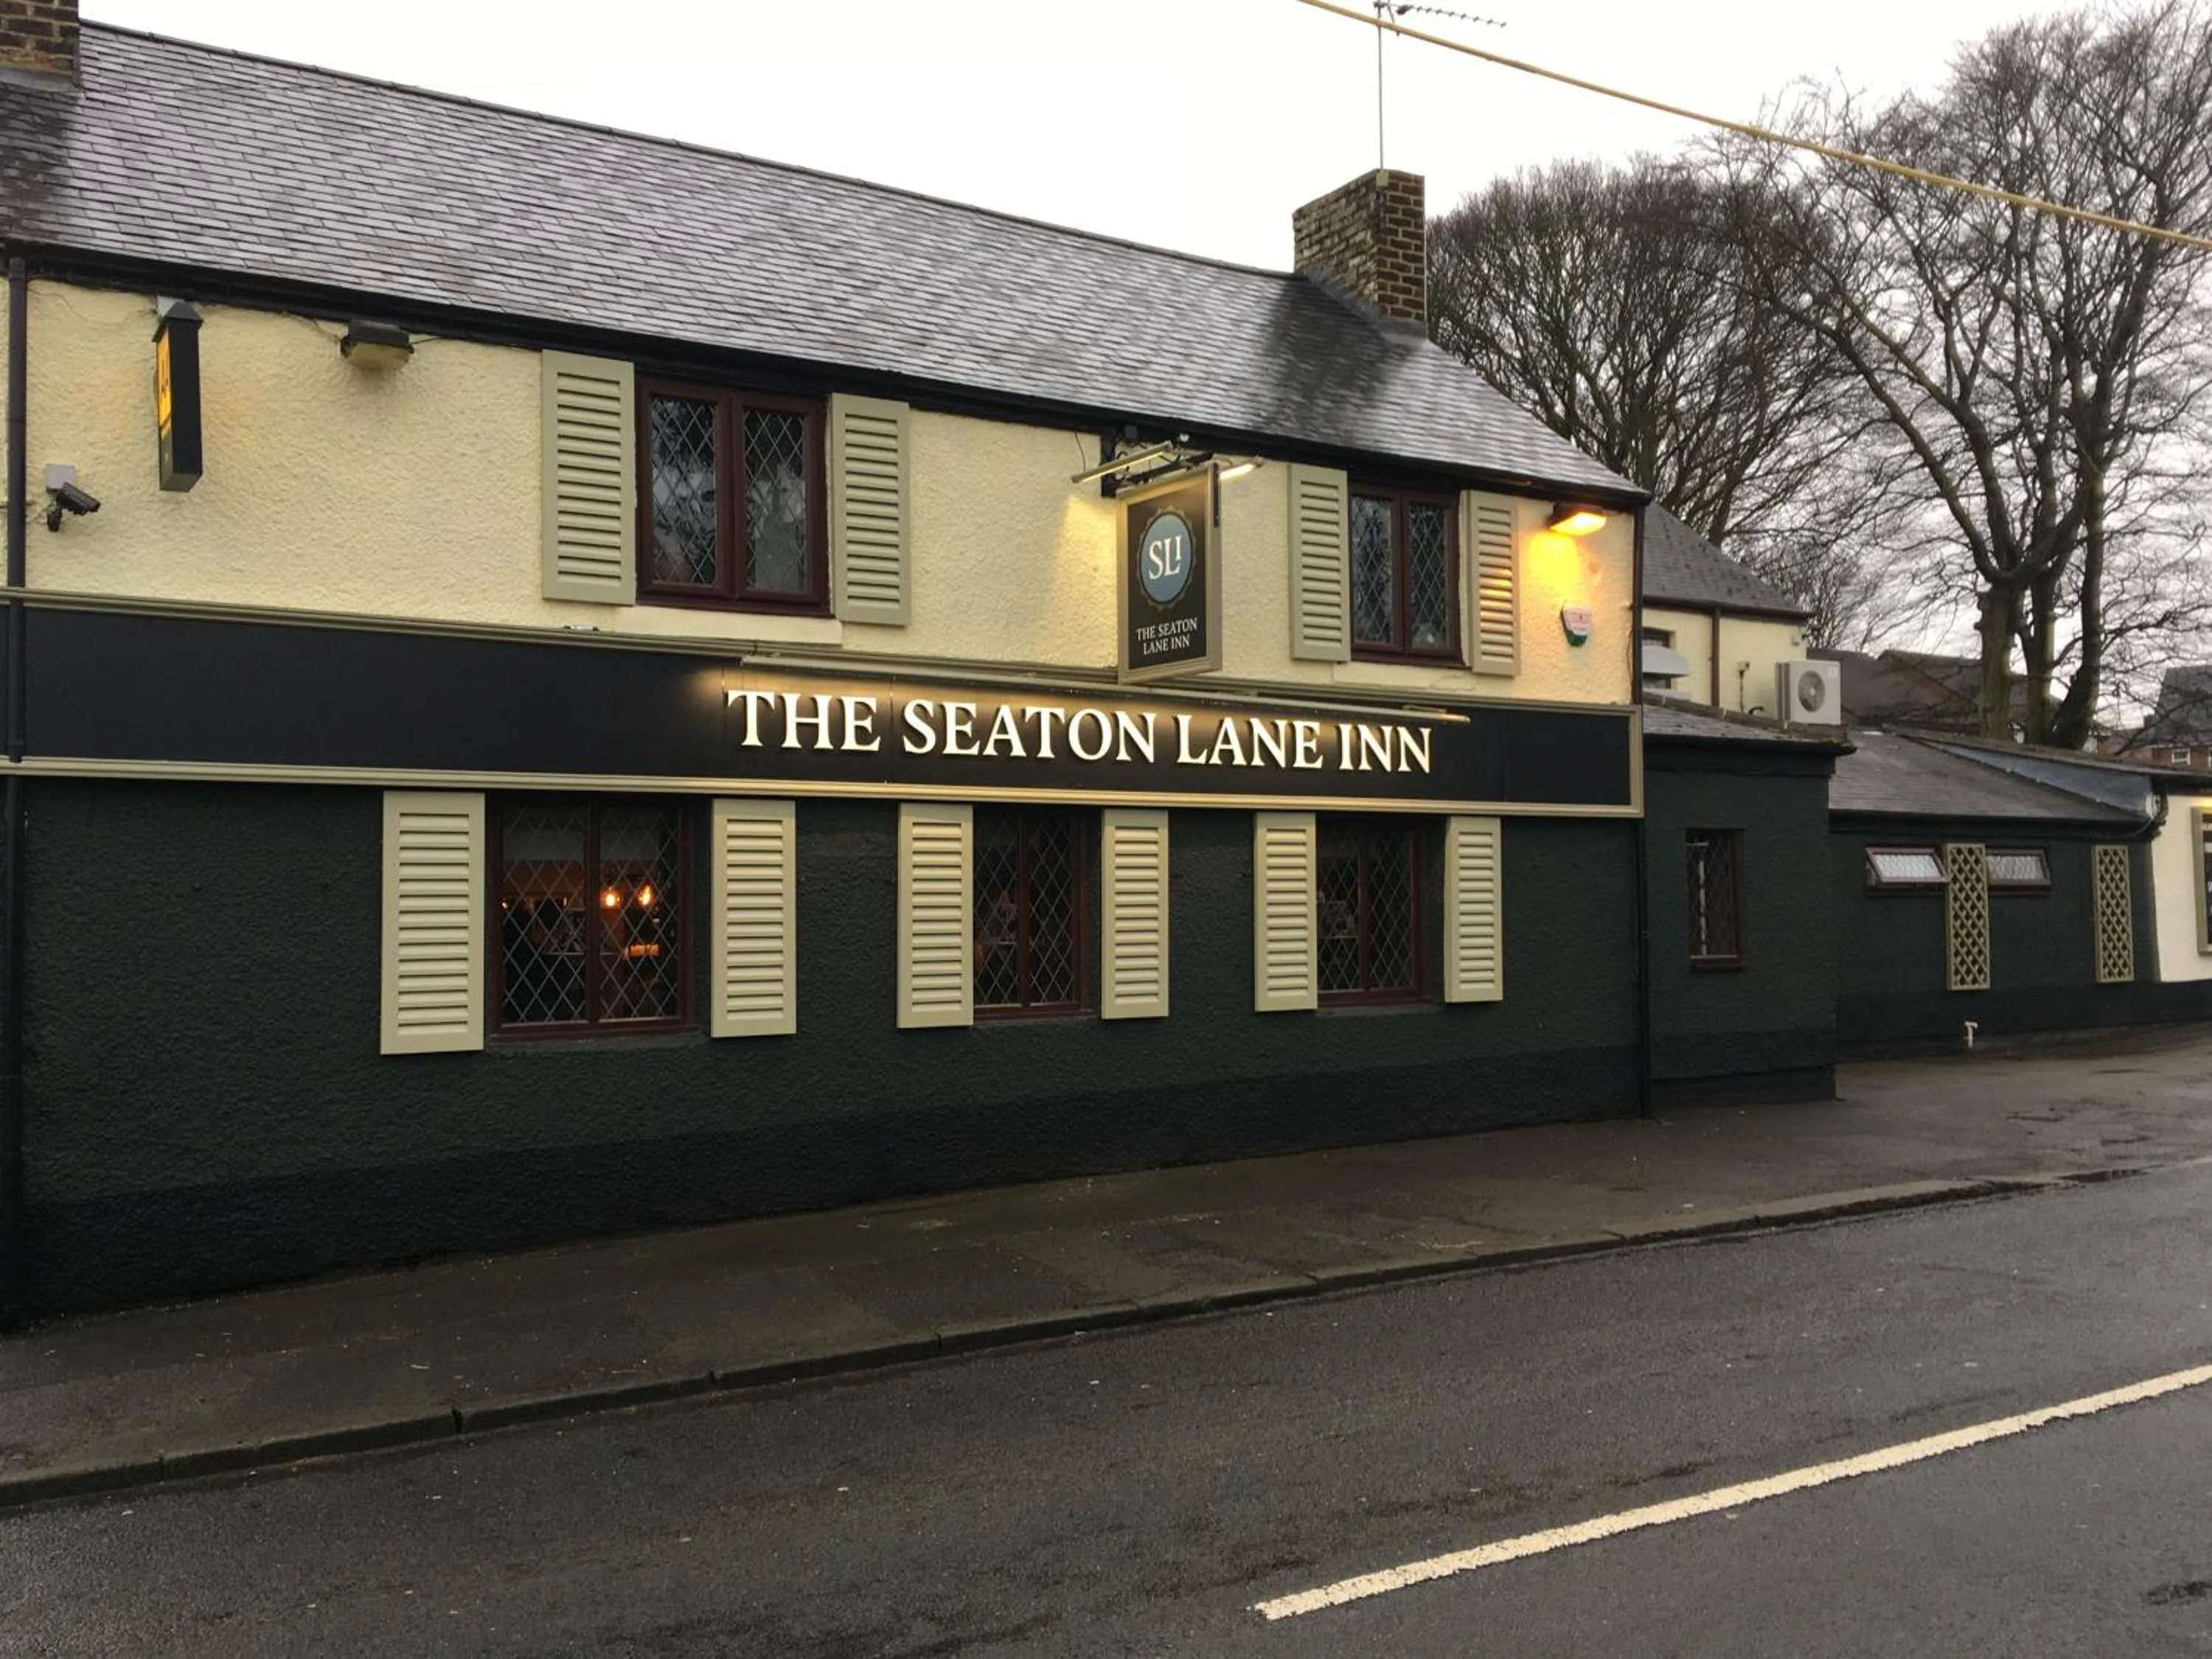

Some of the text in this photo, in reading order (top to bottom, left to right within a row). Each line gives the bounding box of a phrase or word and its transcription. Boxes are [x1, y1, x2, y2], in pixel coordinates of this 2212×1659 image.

[1135, 617, 1197, 641] THE SEATON
[1144, 633, 1189, 655] LANE INN
[727, 689, 1433, 774] THE SEATON LANE INN
